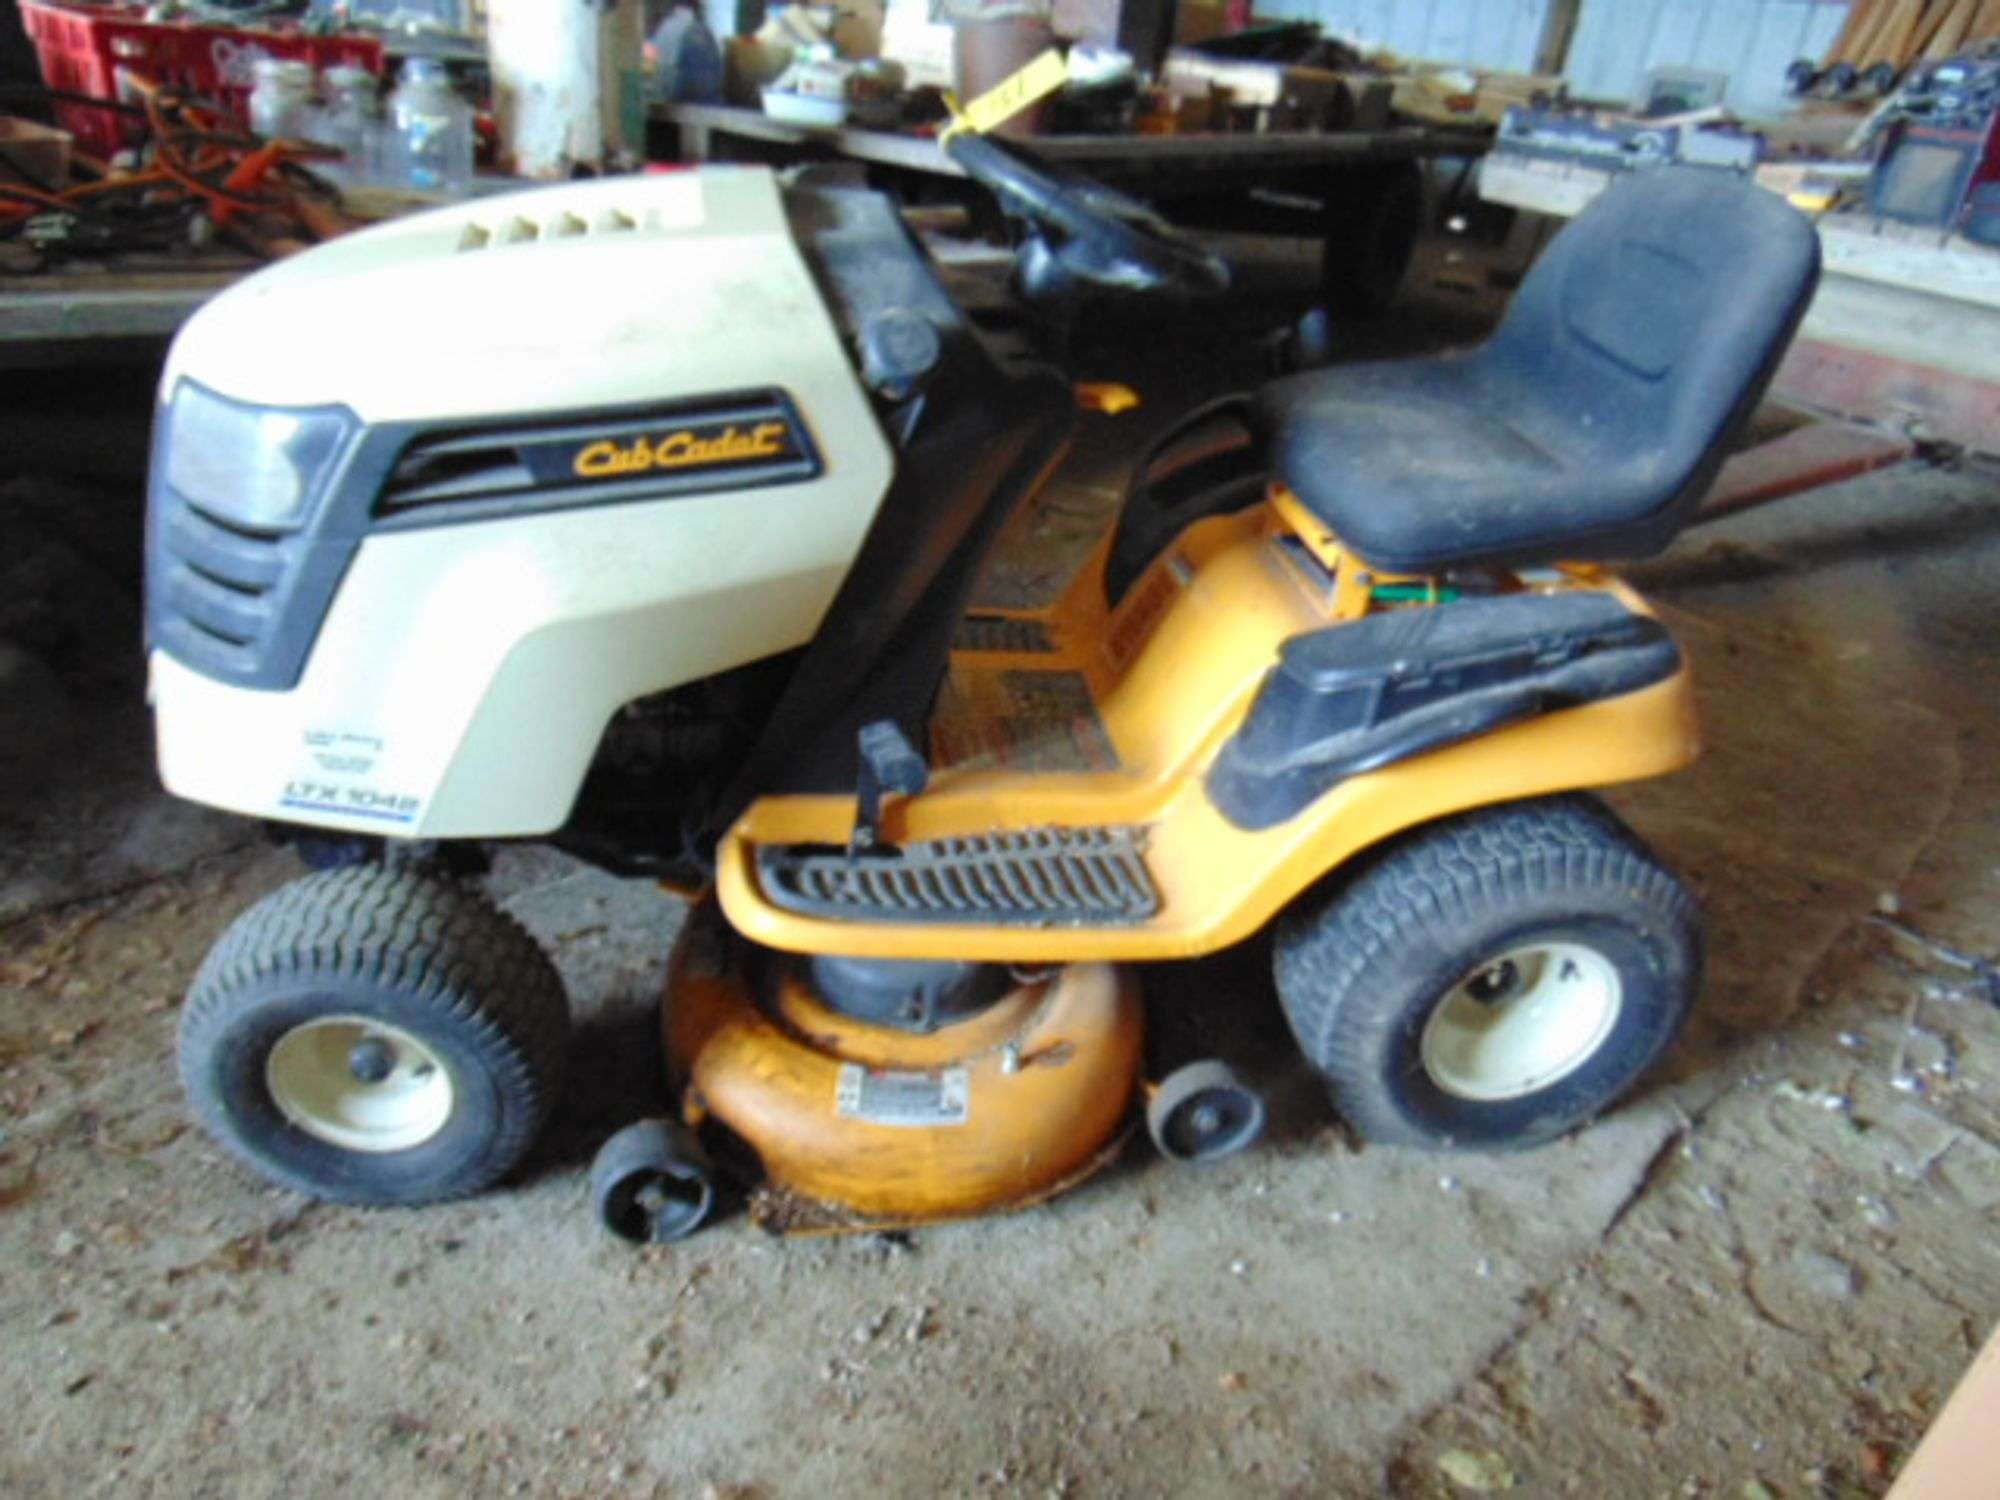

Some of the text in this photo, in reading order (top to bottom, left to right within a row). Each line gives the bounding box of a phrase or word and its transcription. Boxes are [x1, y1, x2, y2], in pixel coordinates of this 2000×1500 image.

[574, 423, 785, 476] Cub Cadet
[283, 781, 340, 801] LTX
